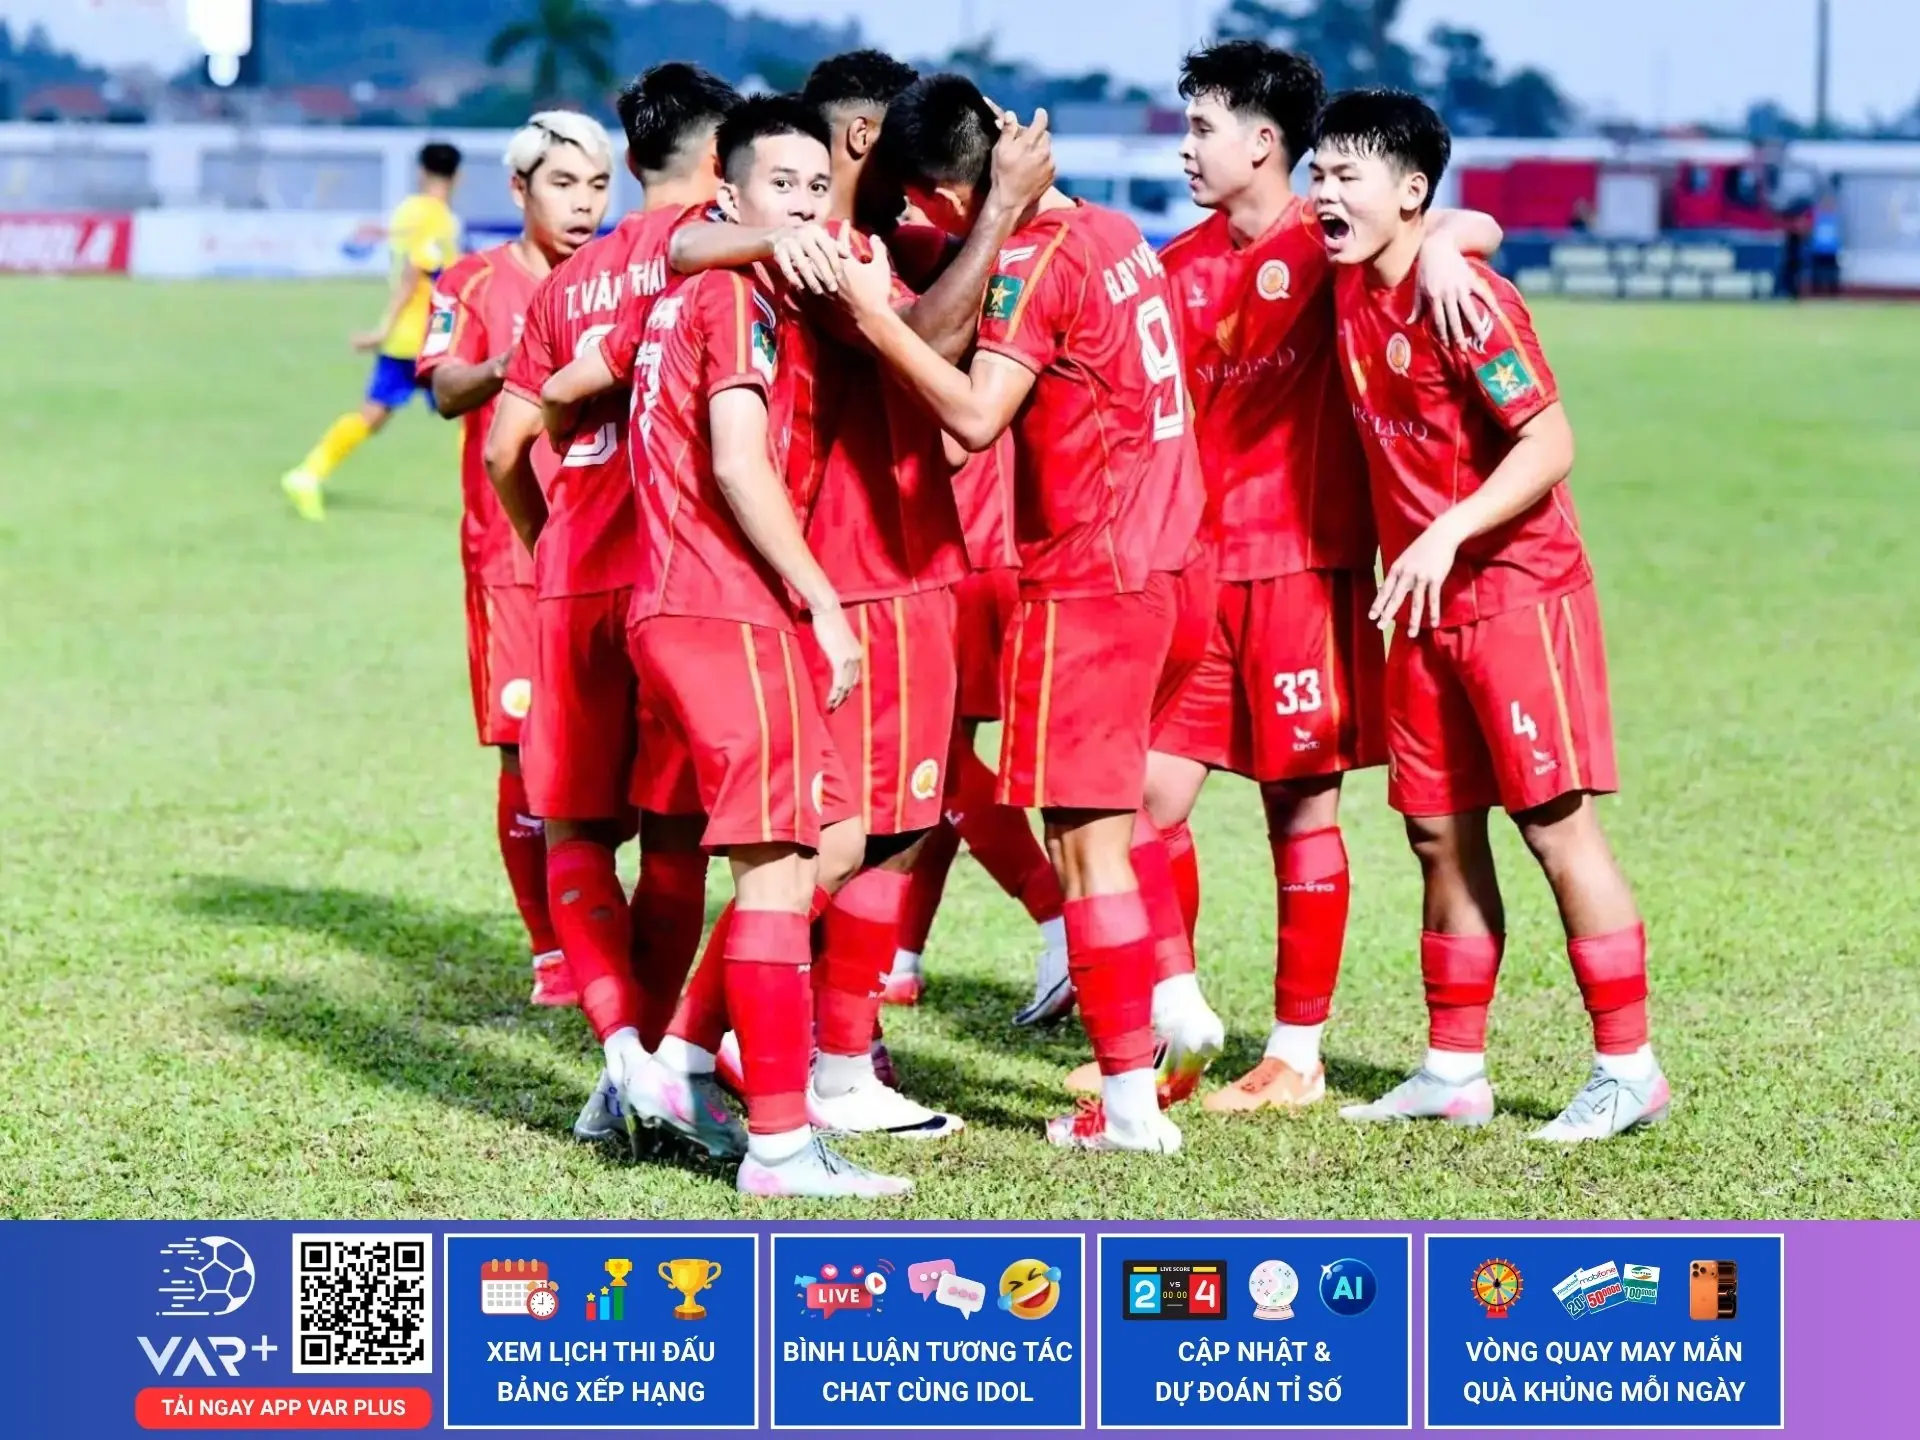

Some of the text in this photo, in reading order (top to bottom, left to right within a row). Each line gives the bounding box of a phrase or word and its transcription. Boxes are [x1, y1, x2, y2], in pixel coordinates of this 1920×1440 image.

[1136, 295, 1184, 441] 9
[1274, 668, 1323, 716] 33
[1510, 701, 1538, 742] 4
